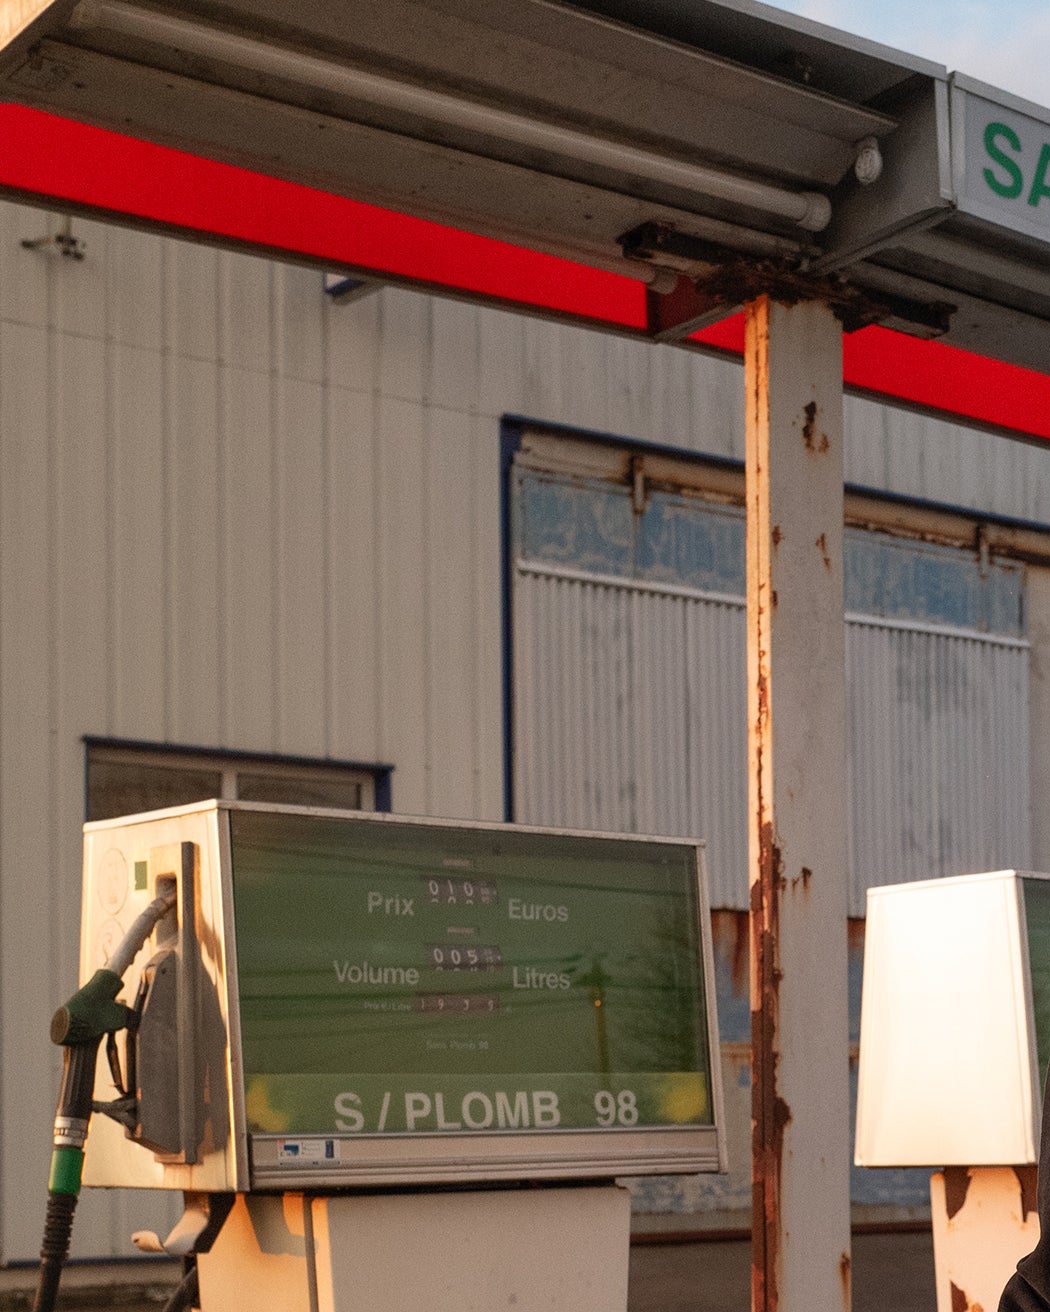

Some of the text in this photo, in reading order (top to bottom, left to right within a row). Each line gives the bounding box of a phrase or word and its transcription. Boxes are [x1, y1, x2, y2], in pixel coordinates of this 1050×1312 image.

[367, 892, 415, 916] Prix
[508, 899, 569, 922] Euros
[334, 960, 420, 985] Volume
[512, 968, 571, 989] Litres
[333, 1092, 366, 1132] S
[405, 1090, 561, 1131] PLOMB
[594, 1089, 640, 1127] 98
